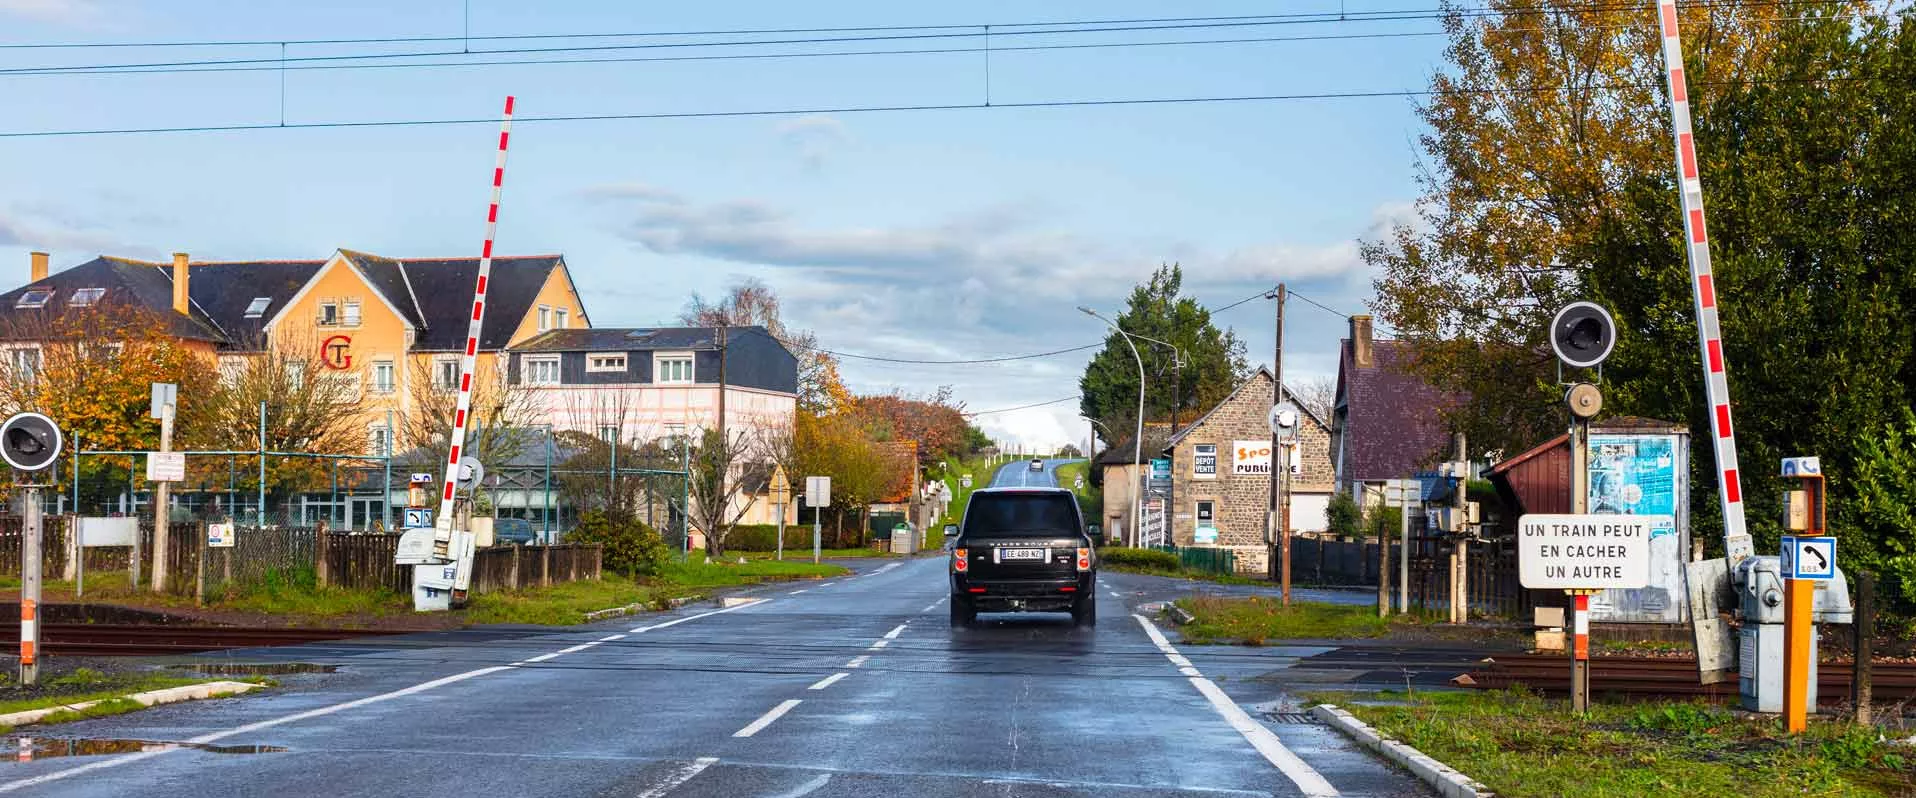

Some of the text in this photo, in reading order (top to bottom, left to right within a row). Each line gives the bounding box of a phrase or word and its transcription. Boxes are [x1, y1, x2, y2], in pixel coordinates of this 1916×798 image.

[1525, 525, 1642, 537] UN TRAIN PEUT
[1540, 545, 1627, 558] EN CACHER
[1546, 566, 1622, 578] UN AUTRE
